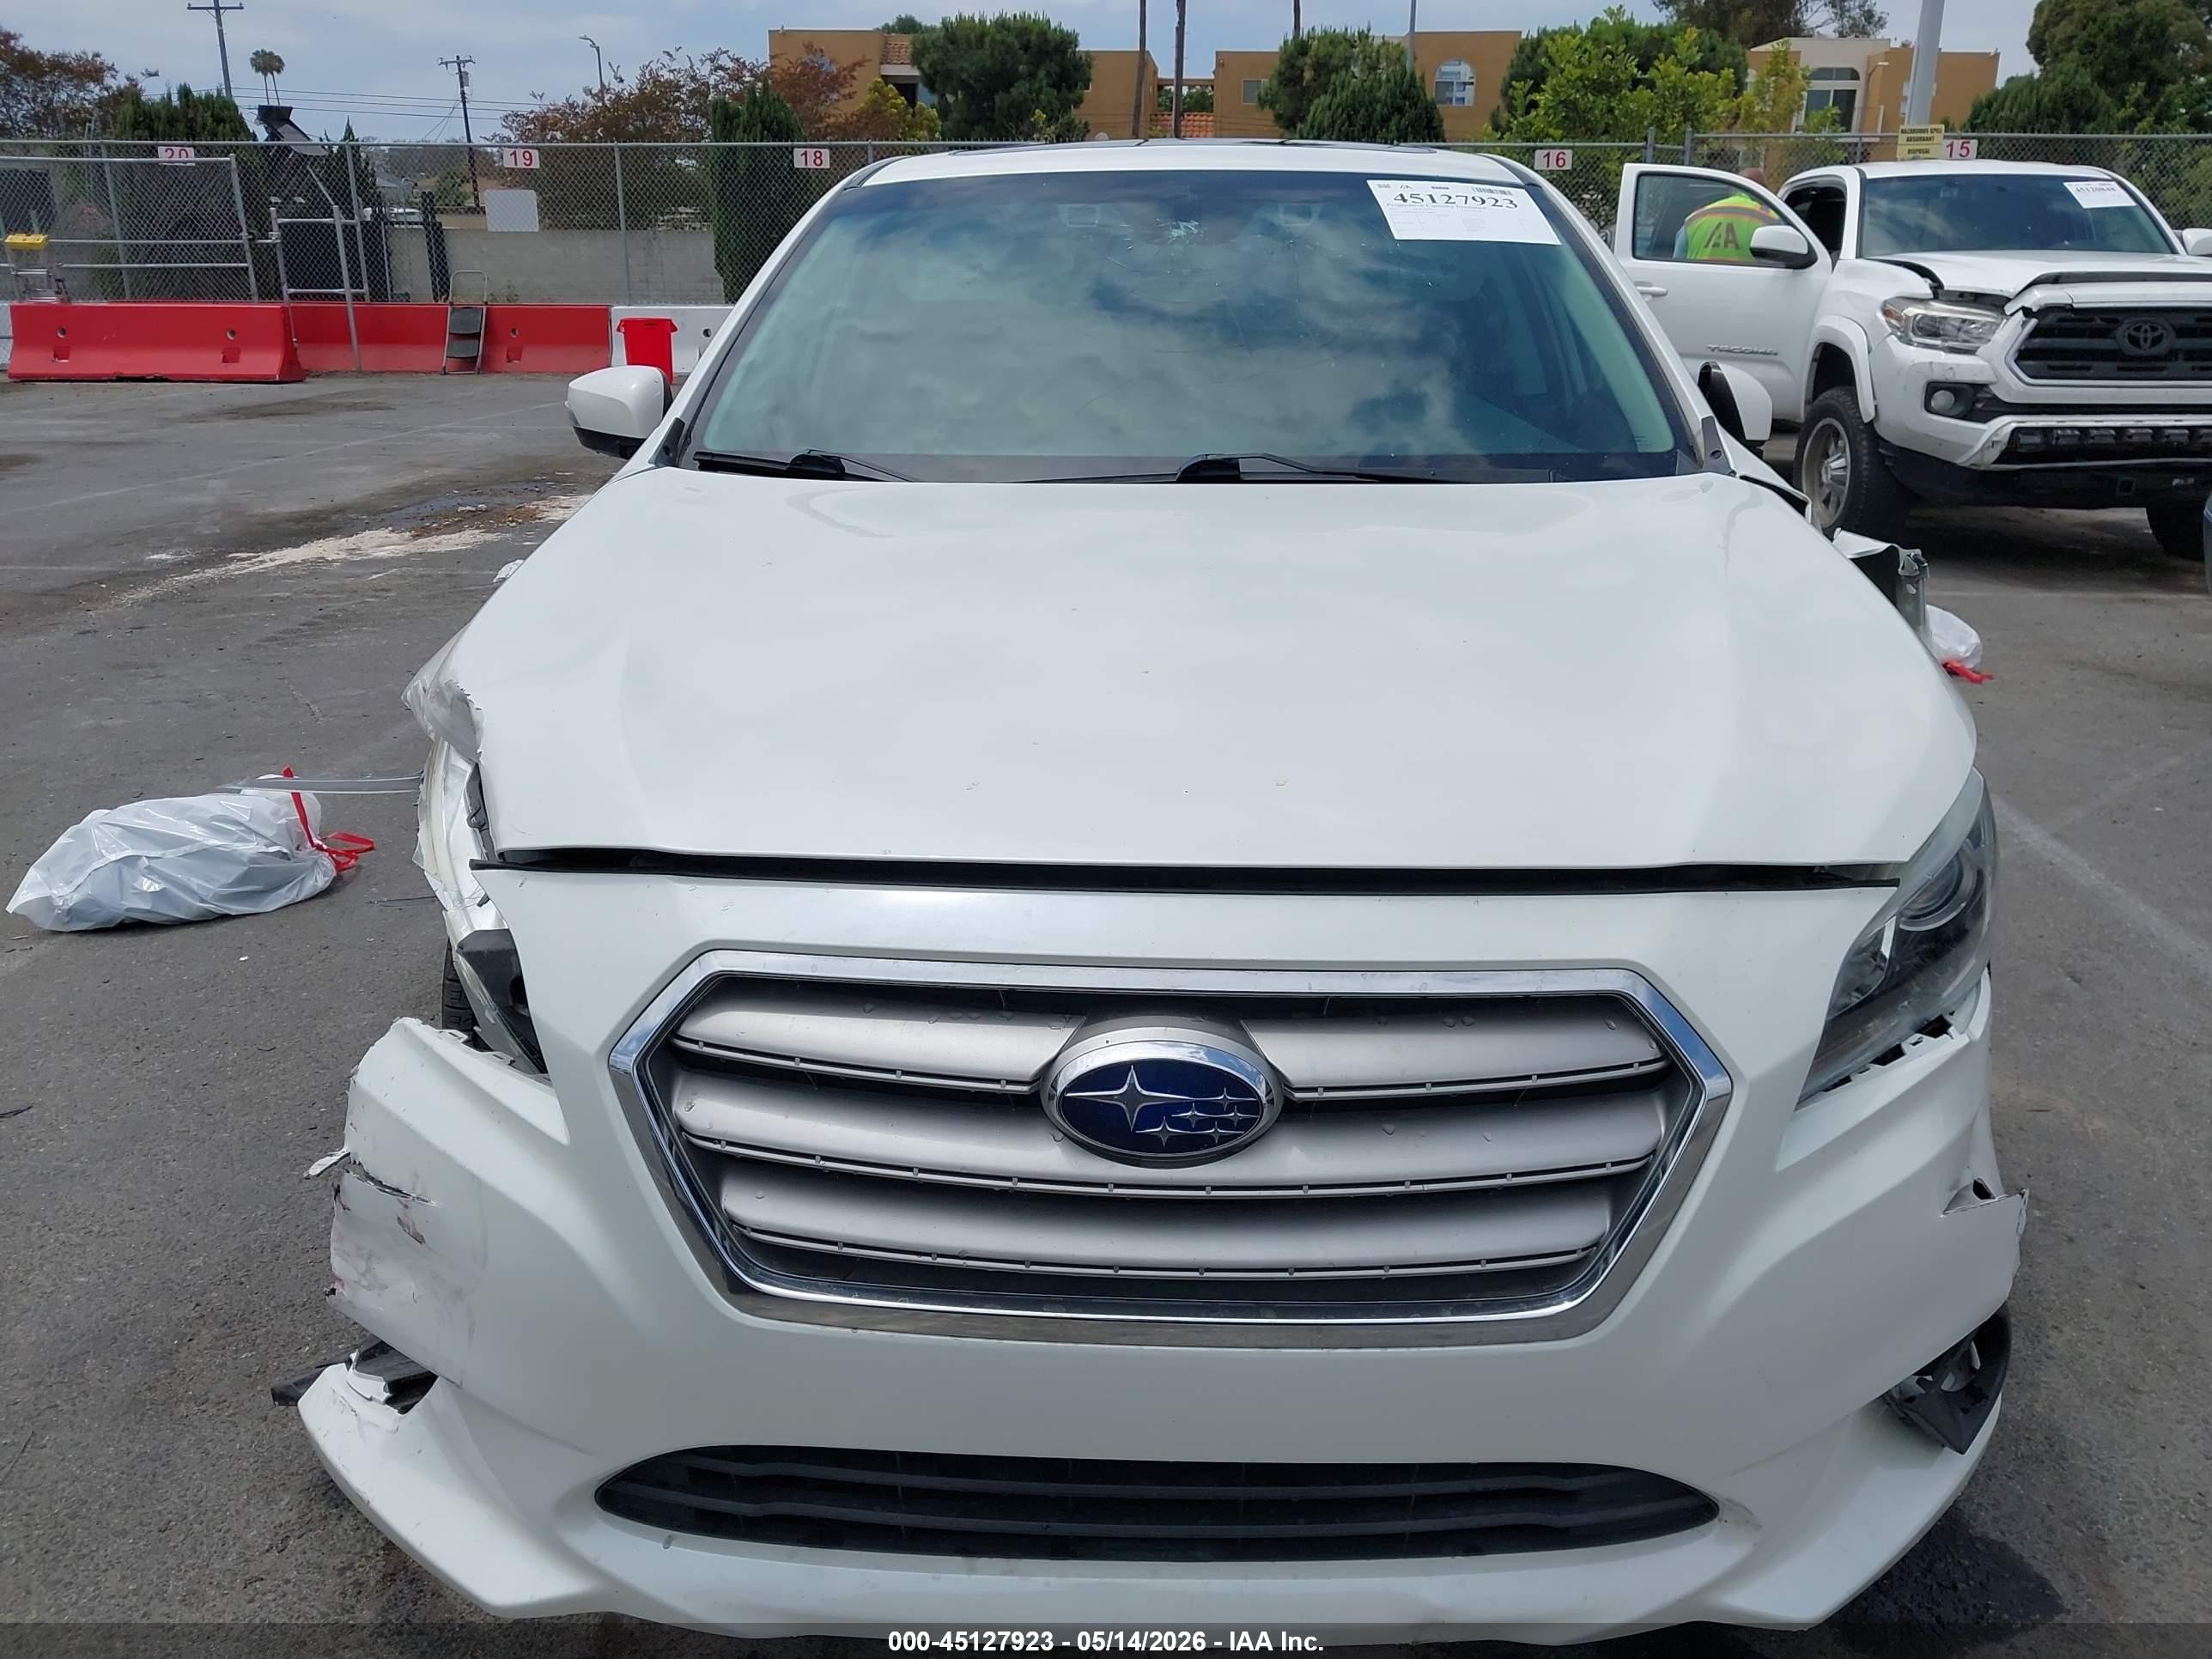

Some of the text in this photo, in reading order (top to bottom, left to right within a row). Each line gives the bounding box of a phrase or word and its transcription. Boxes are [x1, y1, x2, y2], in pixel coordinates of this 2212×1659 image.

[164, 147, 189, 159] 20
[509, 149, 533, 167] 19
[800, 149, 823, 167] 18
[1946, 140, 1971, 158] 15
[1542, 150, 1566, 168] 16
[1394, 192, 1518, 210] 45127923
[1706, 344, 1778, 356] TACOMA
